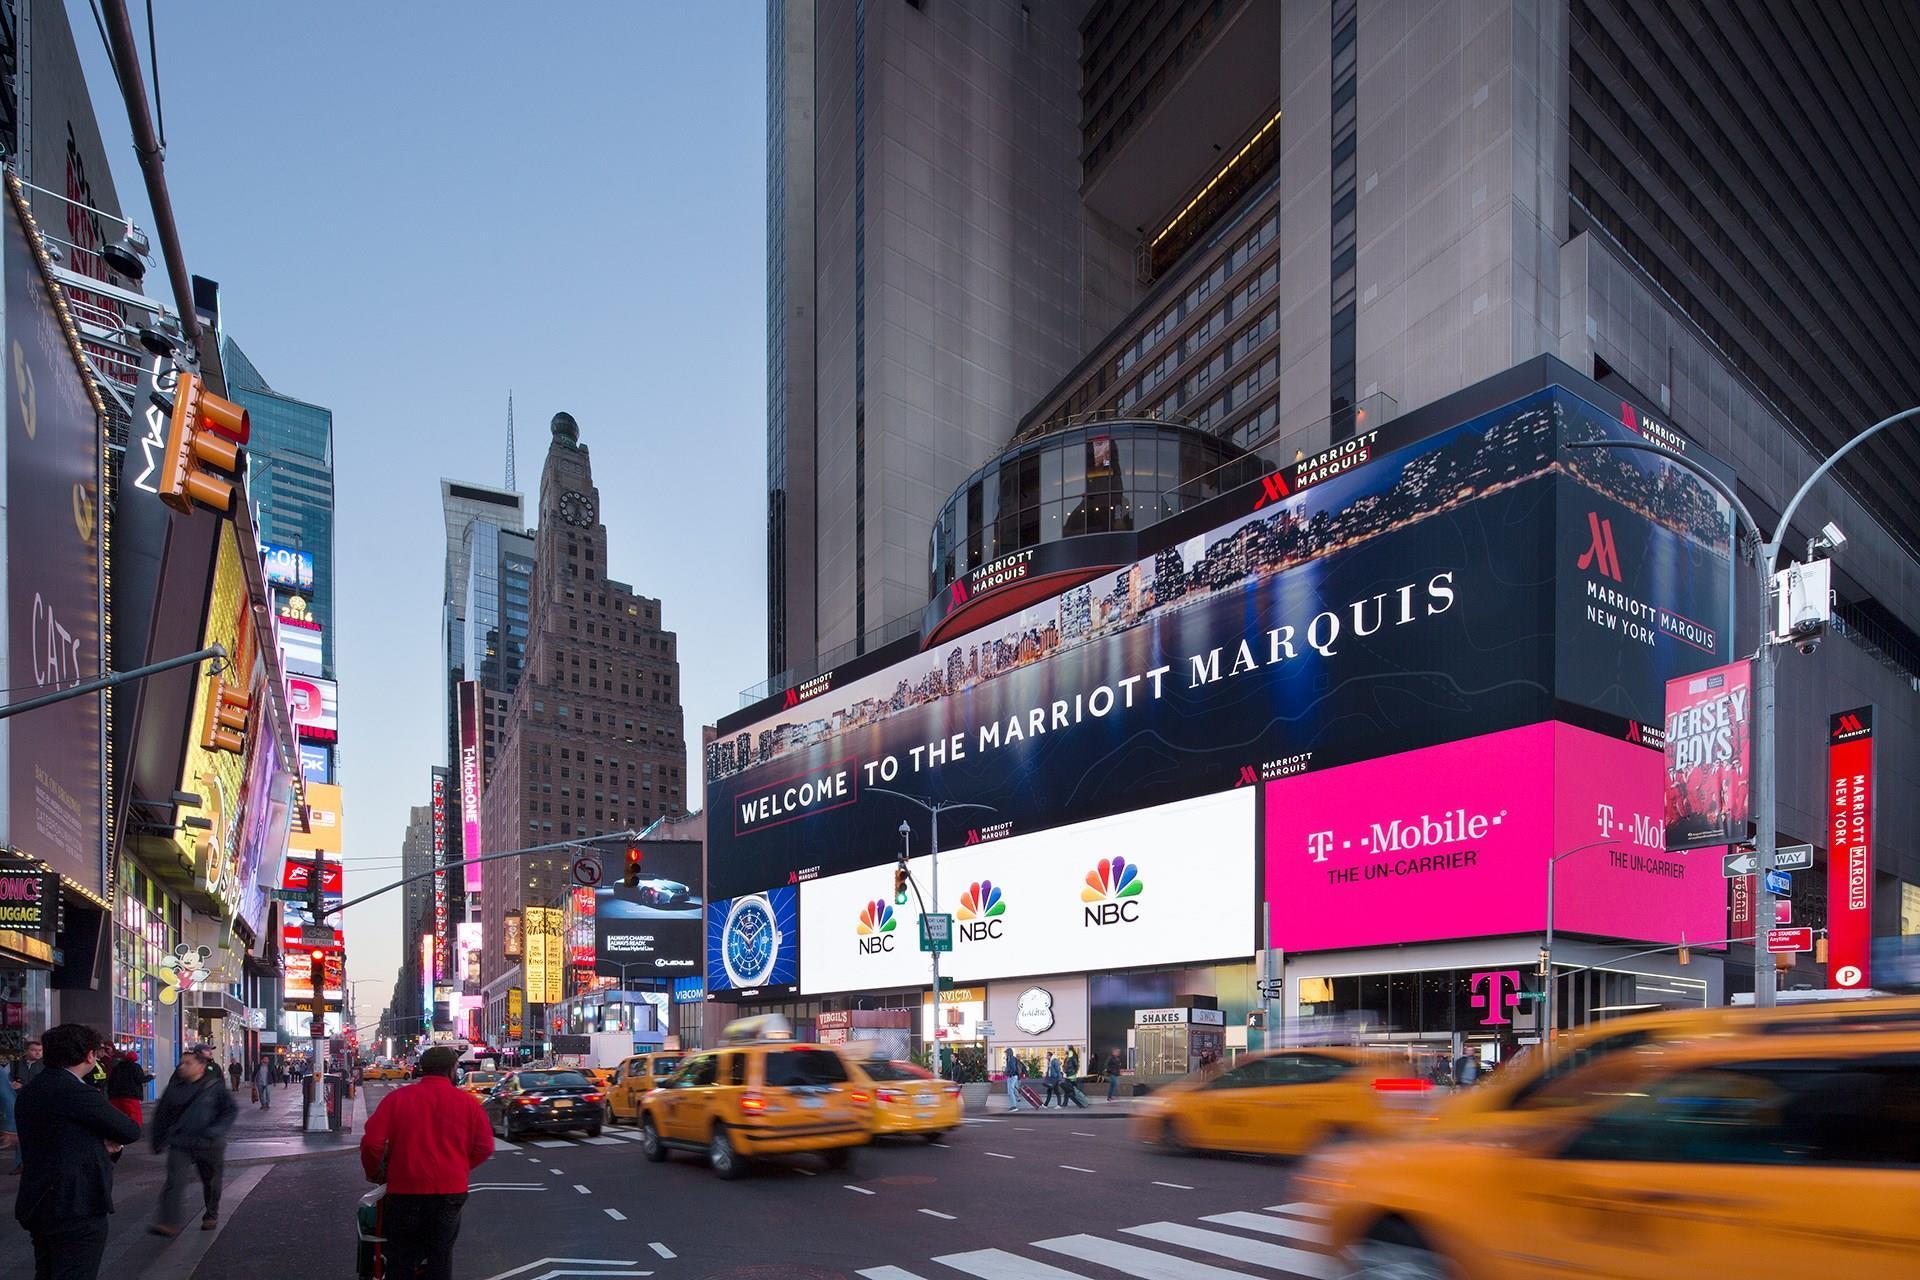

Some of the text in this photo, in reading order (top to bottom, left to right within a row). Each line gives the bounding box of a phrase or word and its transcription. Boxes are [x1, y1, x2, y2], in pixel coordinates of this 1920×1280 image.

[1643, 417, 1686, 450] MARRIOTT
[1297, 431, 1378, 473] MARRIOTT
[1297, 446, 1369, 489] MARQUIS
[972, 550, 1034, 581] MARRIOTT
[972, 564, 1026, 593] MARQUIS
[1587, 580, 1714, 650] MARRIOTT MARQUIS
[1587, 605, 1655, 647] NEW YORK
[32, 592, 81, 691] CATS
[800, 671, 832, 692] MARRIOTT
[800, 682, 829, 701] MARQUIS
[741, 571, 1455, 824] WELCOME TO THE MARRIOTT MARQUIS
[1666, 689, 1747, 743] JERSEY
[1643, 725, 1666, 738] MARRIO
[1839, 728, 1871, 739] MARRIOTT
[1262, 752, 1312, 770] MARRIOTT
[1675, 726, 1733, 772] BOYS
[1262, 762, 1307, 779] MARQUIS
[1835, 778, 1846, 845] NEW YORK
[982, 821, 1013, 833] MARRIOTT
[982, 829, 1009, 841] MARQUIS
[1852, 775, 1865, 908] MARRIOTT MARQUIS
[799, 866, 820, 876] MARRIOTT
[1327, 849, 1478, 886] THE UN-CARRIER
[1608, 850, 1685, 880] THE UN-CARRIER
[1776, 853, 1802, 864] WAY
[799, 871, 818, 883] MARQUIS
[1084, 900, 1139, 927] NBC
[859, 934, 894, 955] NBC
[960, 919, 1003, 943] NBC
[939, 989, 973, 1001] NVICTA
[1471, 970, 1520, 1025] T
[819, 1011, 848, 1024] VIRGIL'S
[1142, 1013, 1180, 1023] SHAKES
